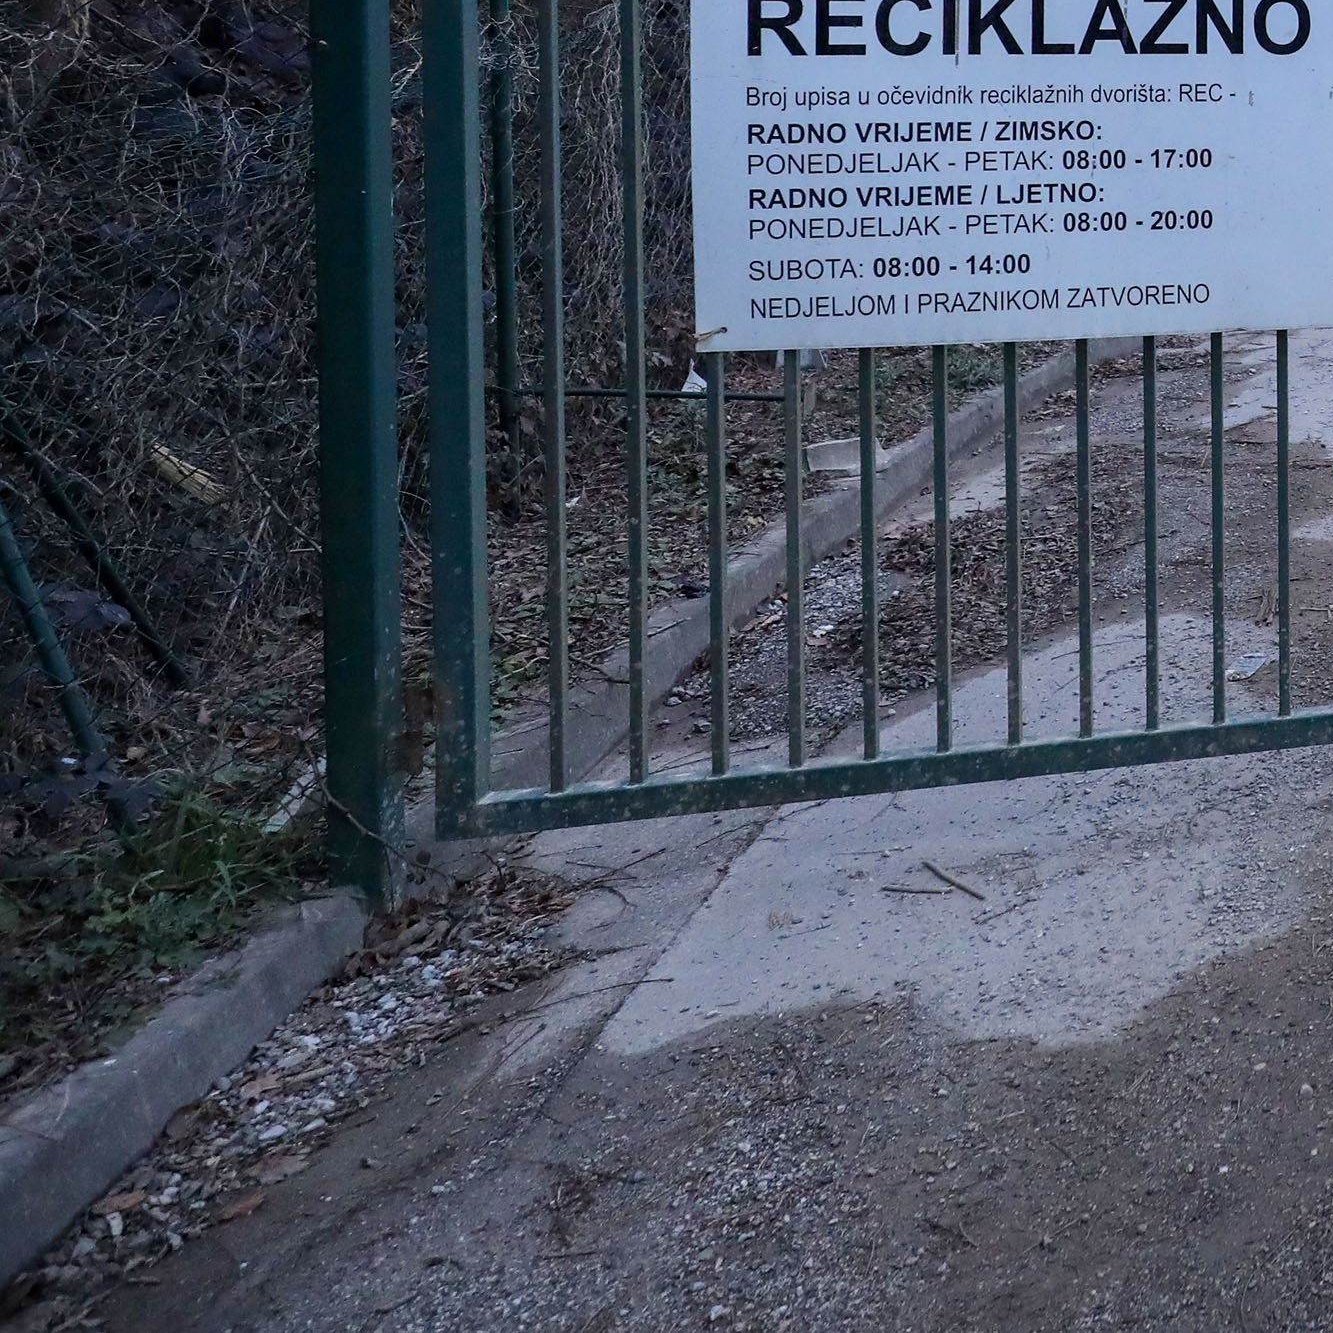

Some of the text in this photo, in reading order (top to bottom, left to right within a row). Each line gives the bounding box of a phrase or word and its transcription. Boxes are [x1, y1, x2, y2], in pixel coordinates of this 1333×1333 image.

[747, 87, 786, 111] Broj
[796, 87, 849, 110] upisa
[859, 91, 869, 105] u
[878, 85, 973, 105] očevidnik
[981, 85, 1083, 104] reciklažnih
[1091, 84, 1170, 102] dvorišta:
[1180, 84, 1222, 102] REC
[748, 120, 1101, 144] RADNO VRIJEME / ZIMSKO:
[748, 152, 939, 175] PONEDJELJAK
[966, 151, 1052, 171] PETAK:
[1063, 150, 1125, 169] 08:00
[1151, 149, 1212, 168] 17:00
[749, 183, 1103, 209] RADNO VRIJEME / LJETNO:
[750, 216, 940, 239] PONEDJELJAK
[966, 213, 1053, 234] PETAK:
[1064, 212, 1126, 232] 08:00
[1151, 210, 1212, 230] 20:00
[749, 259, 863, 281] SUBOTA:
[874, 256, 939, 277] 08:00
[966, 254, 1030, 274] 14:00
[751, 295, 895, 318] NEDJELJOM
[919, 289, 1058, 313] PRAZNIKOM
[1067, 284, 1209, 308] ZATVORENO
